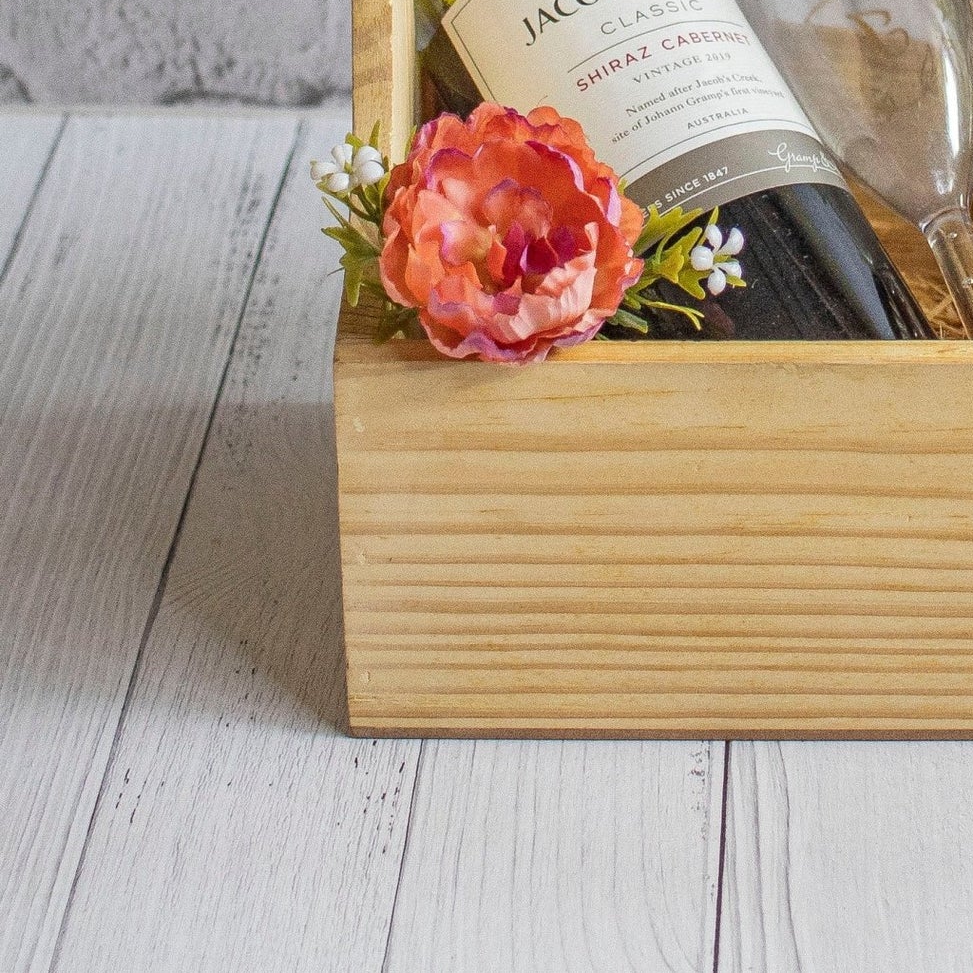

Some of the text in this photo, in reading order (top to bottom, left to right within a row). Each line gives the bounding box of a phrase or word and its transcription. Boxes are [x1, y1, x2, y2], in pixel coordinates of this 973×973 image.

[600, 0, 703, 35] CLASSIC
[576, 31, 751, 92] SHIRAZ CABERNET
[632, 52, 732, 84] VINTAGE 2019
[611, 129, 630, 144] site
[632, 119, 643, 133] of
[644, 103, 685, 125] Johann
[685, 89, 731, 107] Gramp's
[732, 85, 751, 96] first
[625, 92, 666, 117] Named
[668, 83, 693, 98] after
[695, 74, 732, 88] Jacob's
[687, 107, 749, 130] AUSTRALIA
[665, 166, 729, 204] SINCE 1847
